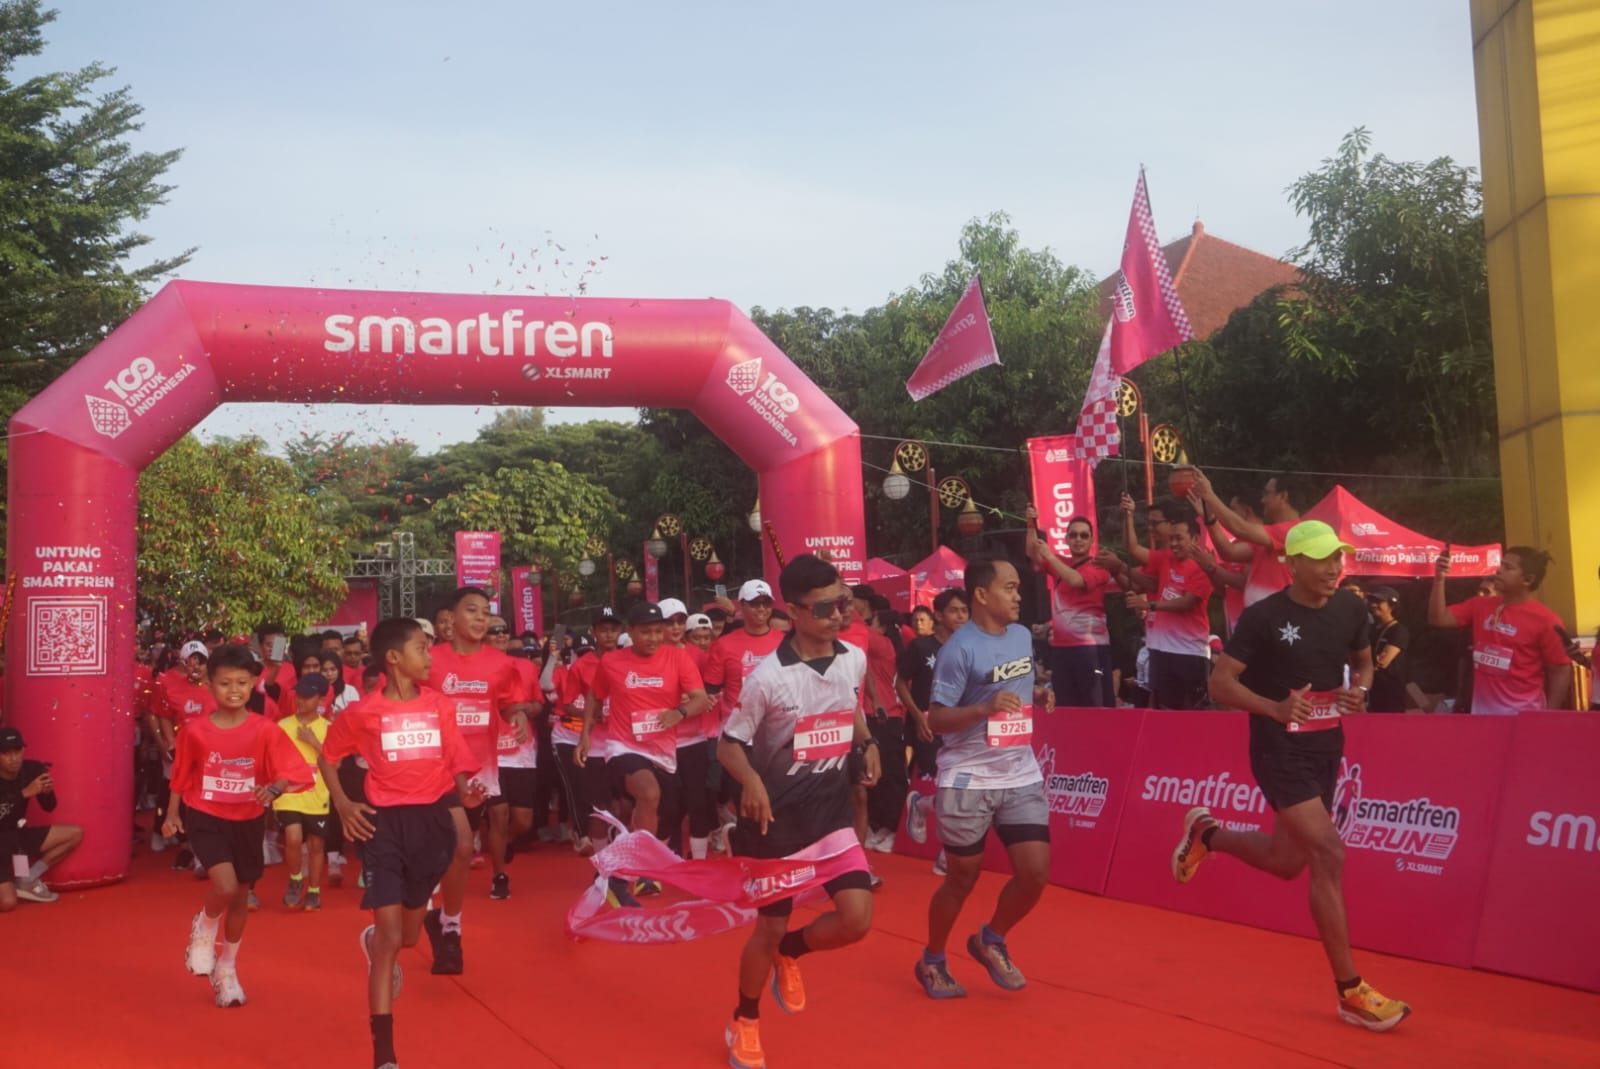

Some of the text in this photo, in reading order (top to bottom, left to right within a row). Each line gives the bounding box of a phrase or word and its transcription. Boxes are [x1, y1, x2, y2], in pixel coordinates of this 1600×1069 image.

[324, 309, 614, 358] smartfren
[544, 367, 612, 380] XLSMART
[125, 372, 167, 408] UNTUK
[133, 363, 197, 417] INDONESIA
[755, 389, 789, 422] UNTUK
[747, 396, 798, 447] INDONESIA
[35, 545, 101, 559] UNTUNG
[805, 535, 855, 548] UNTUNG
[42, 561, 94, 573] PAKAI
[1354, 551, 1397, 565] Untung
[1398, 552, 1427, 564] Pakai
[22, 575, 115, 588] SMARTFREN
[992, 655, 1033, 683] K25
[808, 729, 841, 746] 11011
[1000, 721, 1027, 735] 9726
[396, 731, 433, 747] 9397
[215, 779, 246, 791] 9377
[1049, 774, 1107, 795] smartfren
[1141, 771, 1267, 814] smartfren
[1356, 801, 1458, 830] smartfren
[1364, 825, 1431, 854] RUN
[1526, 811, 1600, 852] sm
